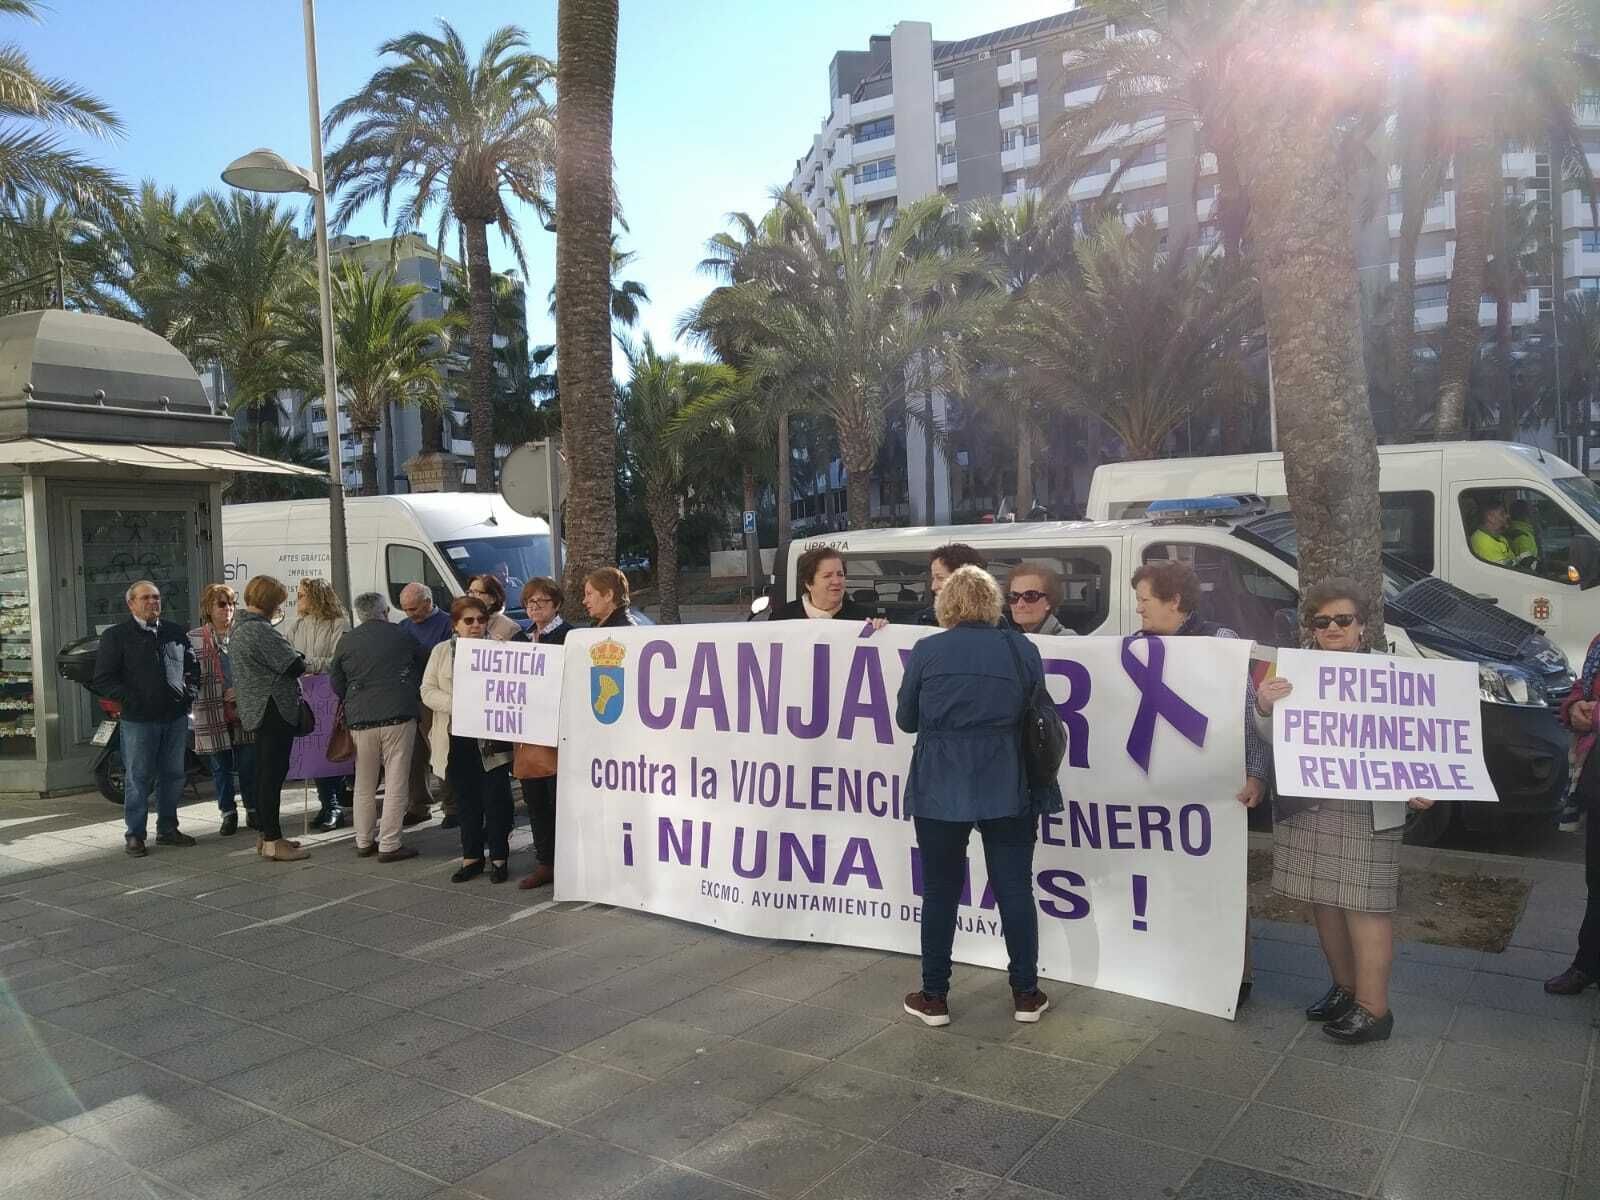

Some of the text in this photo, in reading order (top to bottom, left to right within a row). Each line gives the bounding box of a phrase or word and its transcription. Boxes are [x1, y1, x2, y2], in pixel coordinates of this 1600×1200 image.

[278, 552, 330, 562] ARTES GRÁFICA
[288, 569, 322, 577] IMPRENTA
[486, 680, 527, 705] PARA
[638, 623, 1090, 768] CANJÁR
[1284, 709, 1472, 754] PERMANENTE
[591, 755, 1211, 857] contra la VIOLENCI ENERO
[658, 816, 711, 869] NI
[731, 826, 883, 890] UNA
[701, 879, 744, 905] EXCMO.
[751, 890, 891, 919] AYUNTAMIENTO
[900, 904, 921, 923] DE
